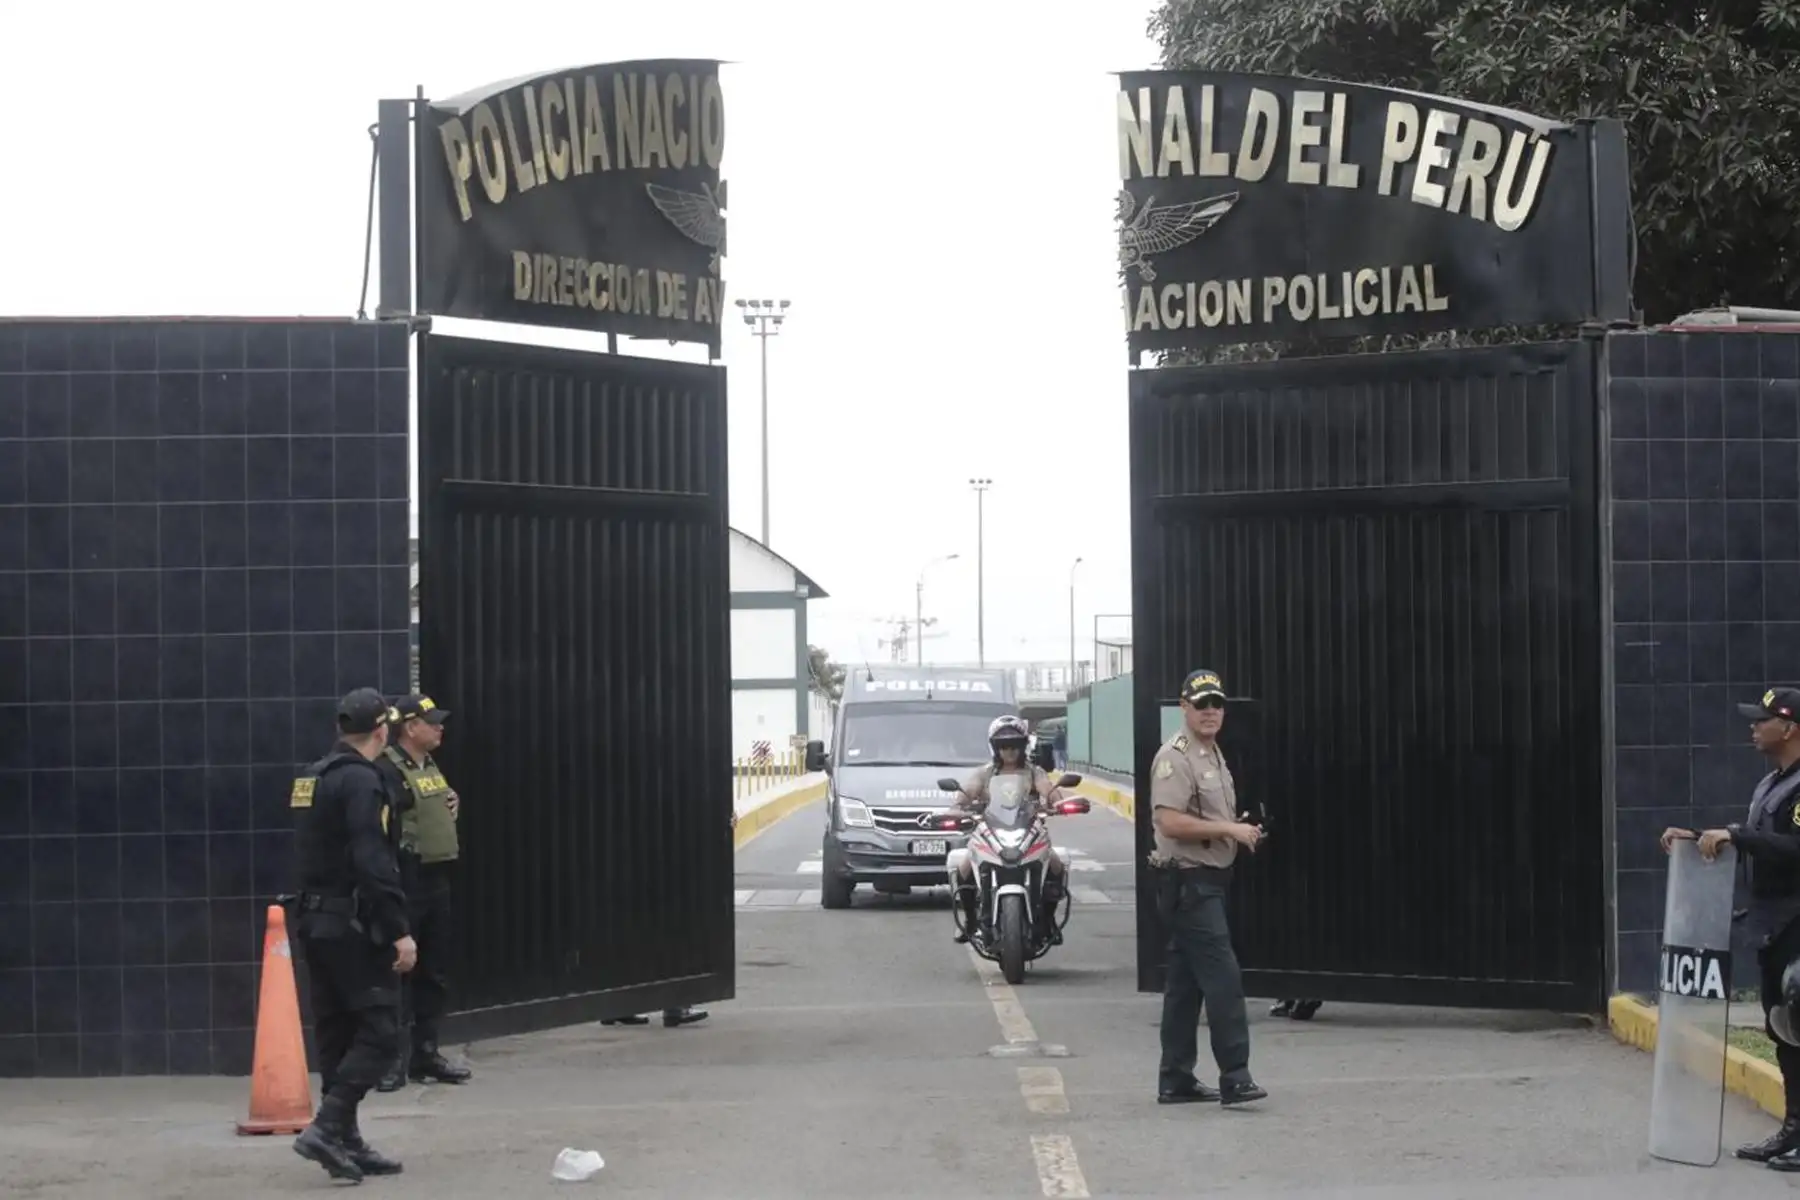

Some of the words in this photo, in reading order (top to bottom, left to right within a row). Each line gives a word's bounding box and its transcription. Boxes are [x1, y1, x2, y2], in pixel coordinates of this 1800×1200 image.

[438, 75, 610, 222] POLICIA
[613, 72, 724, 169] NACIO
[1118, 84, 1230, 180] NAL
[1235, 87, 1359, 188] DEL
[1378, 101, 1551, 232] PERÚ
[512, 249, 650, 315] DIRECCION
[656, 269, 688, 320] DE
[695, 276, 726, 324] AV
[1263, 264, 1449, 322] POLICIAL
[866, 680, 992, 692] POLICIA
